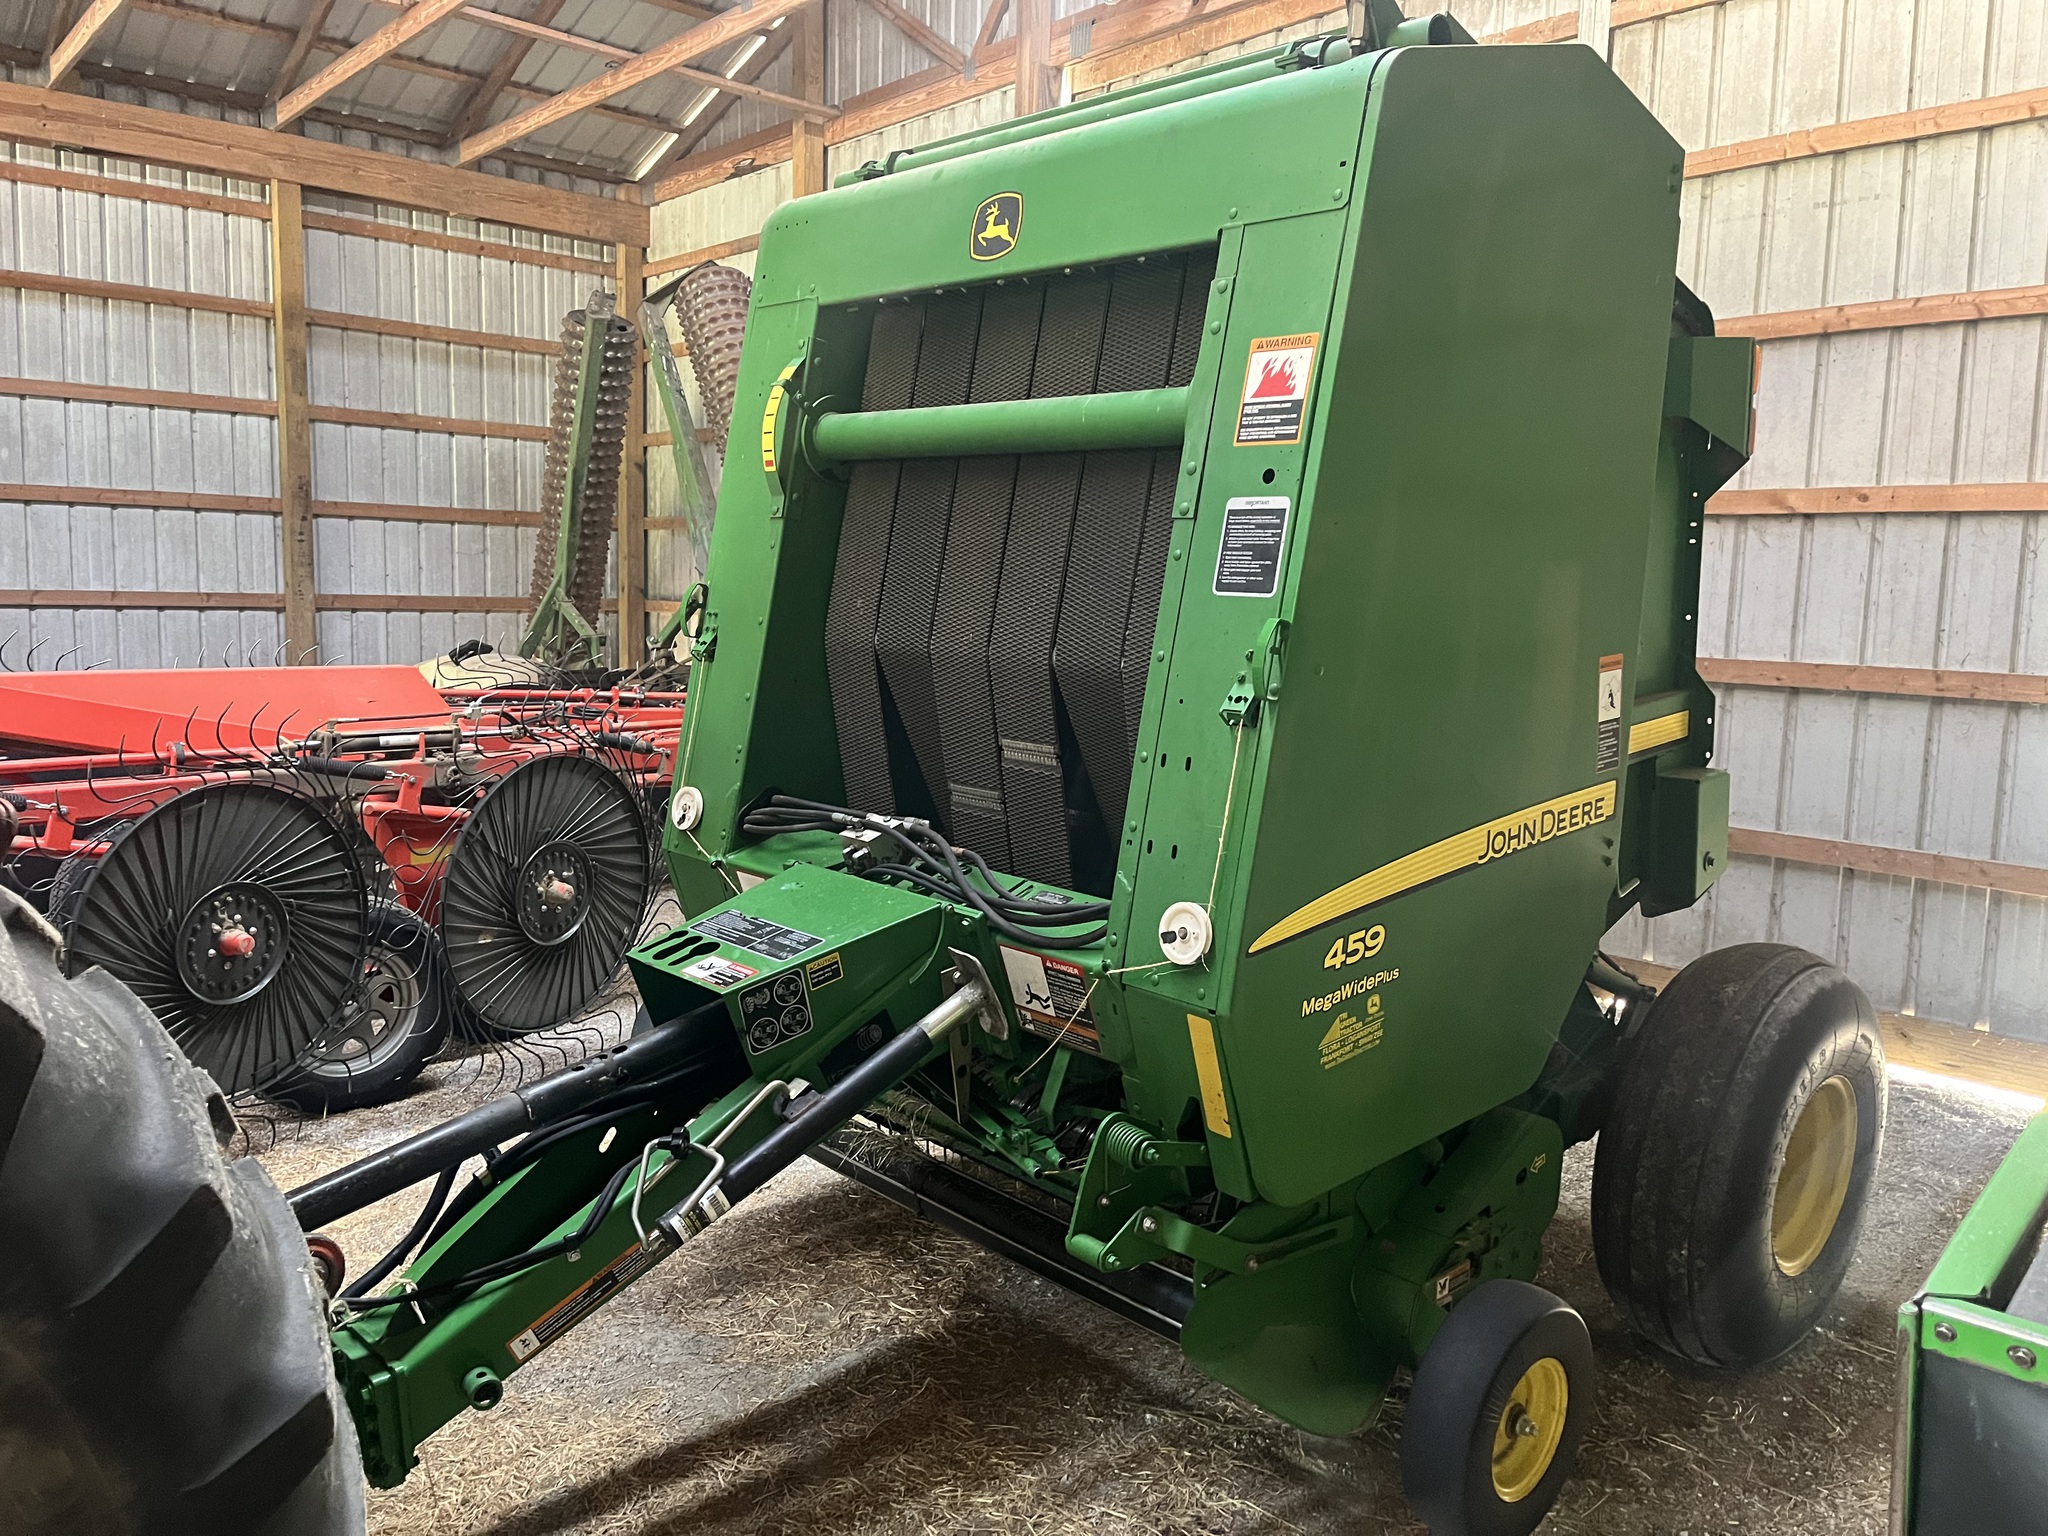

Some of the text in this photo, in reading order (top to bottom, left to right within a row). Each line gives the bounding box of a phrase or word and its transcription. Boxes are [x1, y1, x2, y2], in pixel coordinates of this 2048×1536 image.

[1265, 335, 1312, 348] WARNING
[1478, 797, 1605, 861] JOHN DEERE
[1052, 962, 1079, 975] DANGER
[1323, 923, 1387, 971] 459
[1301, 968, 1400, 1017] MegaWidePlus
